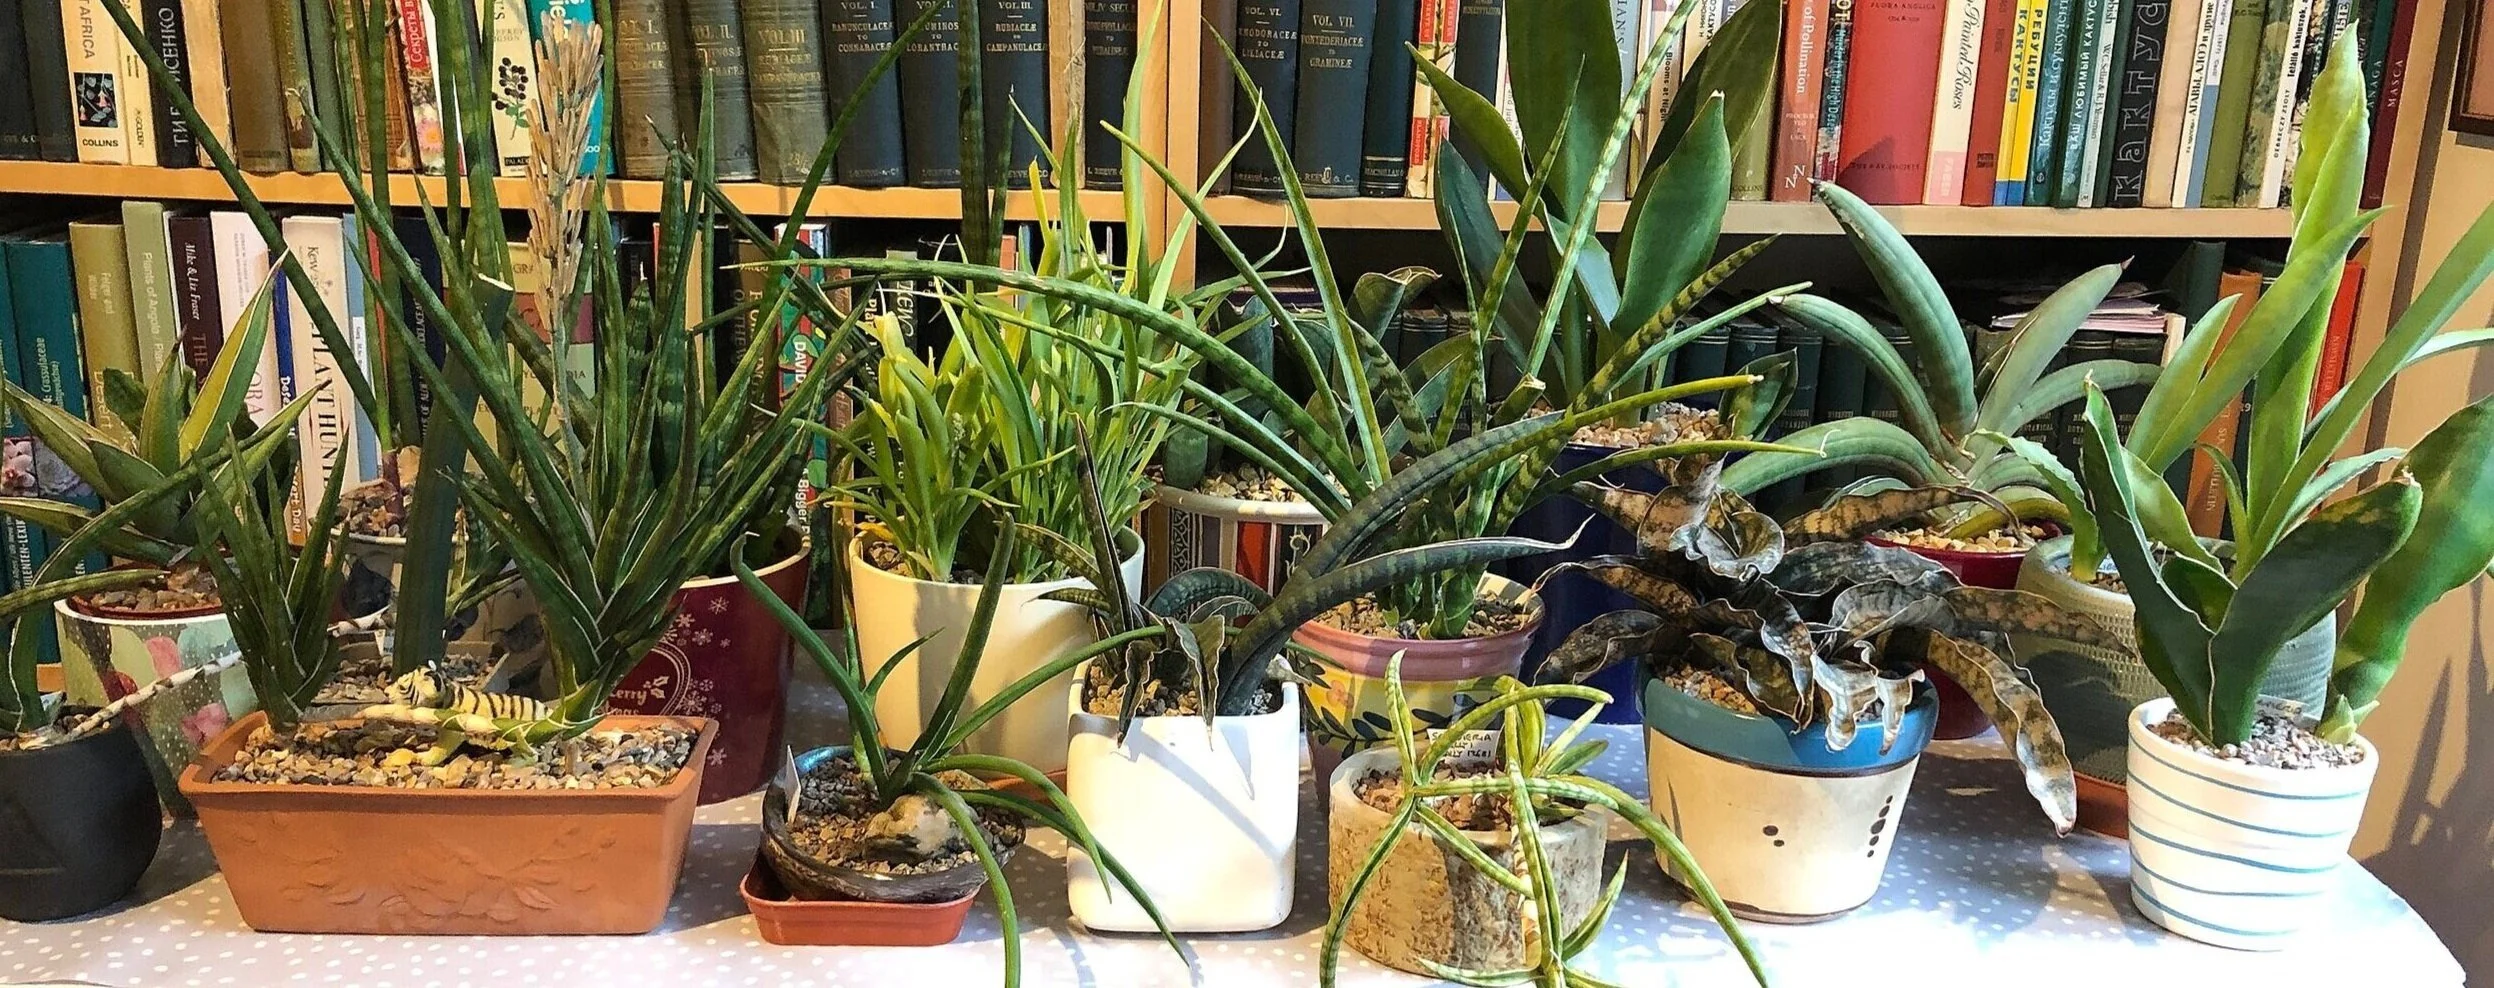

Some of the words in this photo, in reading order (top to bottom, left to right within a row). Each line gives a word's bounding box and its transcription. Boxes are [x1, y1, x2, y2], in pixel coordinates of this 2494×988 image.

[1313, 15, 1333, 27] VOL.
[1339, 17, 1355, 28] VII.
[1804, 8, 1817, 22] of
[79, 6, 96, 59] AFRICA
[407, 12, 423, 63] Секреты
[906, 43, 959, 53] LORANTHAC
[1257, 40, 1269, 48] TO
[1309, 57, 1353, 69] GRAMINEÆ
[1797, 23, 1816, 94] Pollination
[2009, 9, 2028, 103] КАКТУСЫ
[2025, 9, 2043, 90] РЕБУЦИИ
[2195, 43, 2207, 77] АЛОЭ
[1664, 52, 1674, 84] Blooms
[2367, 60, 2383, 109] ANAGA
[2387, 60, 2404, 108] MASCA
[1662, 87, 1669, 97] at
[1827, 86, 1841, 105] High
[1952, 61, 1973, 110] Roses
[2069, 123, 2081, 150] ВАШ
[2075, 52, 2091, 119] ЛЮБИМЫЙ
[2038, 90, 2059, 149] Кактусы
[82, 138, 119, 147] COLLINS
[2273, 115, 2287, 158] DEBRECZY
[143, 252, 154, 284] Plants
[185, 242, 195, 265] Mike
[308, 246, 319, 274] Kew
[188, 265, 198, 276] &
[147, 285, 157, 298] of
[191, 291, 201, 321] Fraser
[148, 299, 161, 334] Angola
[36, 337, 51, 393] Crassulaceae
[192, 336, 209, 367] THE
[794, 341, 807, 383] DAVID
[94, 370, 114, 429] Desert
[249, 371, 265, 415] ORA
[795, 479, 810, 522] Bigger
[292, 509, 302, 533] Day
[609, 688, 647, 706] erry
